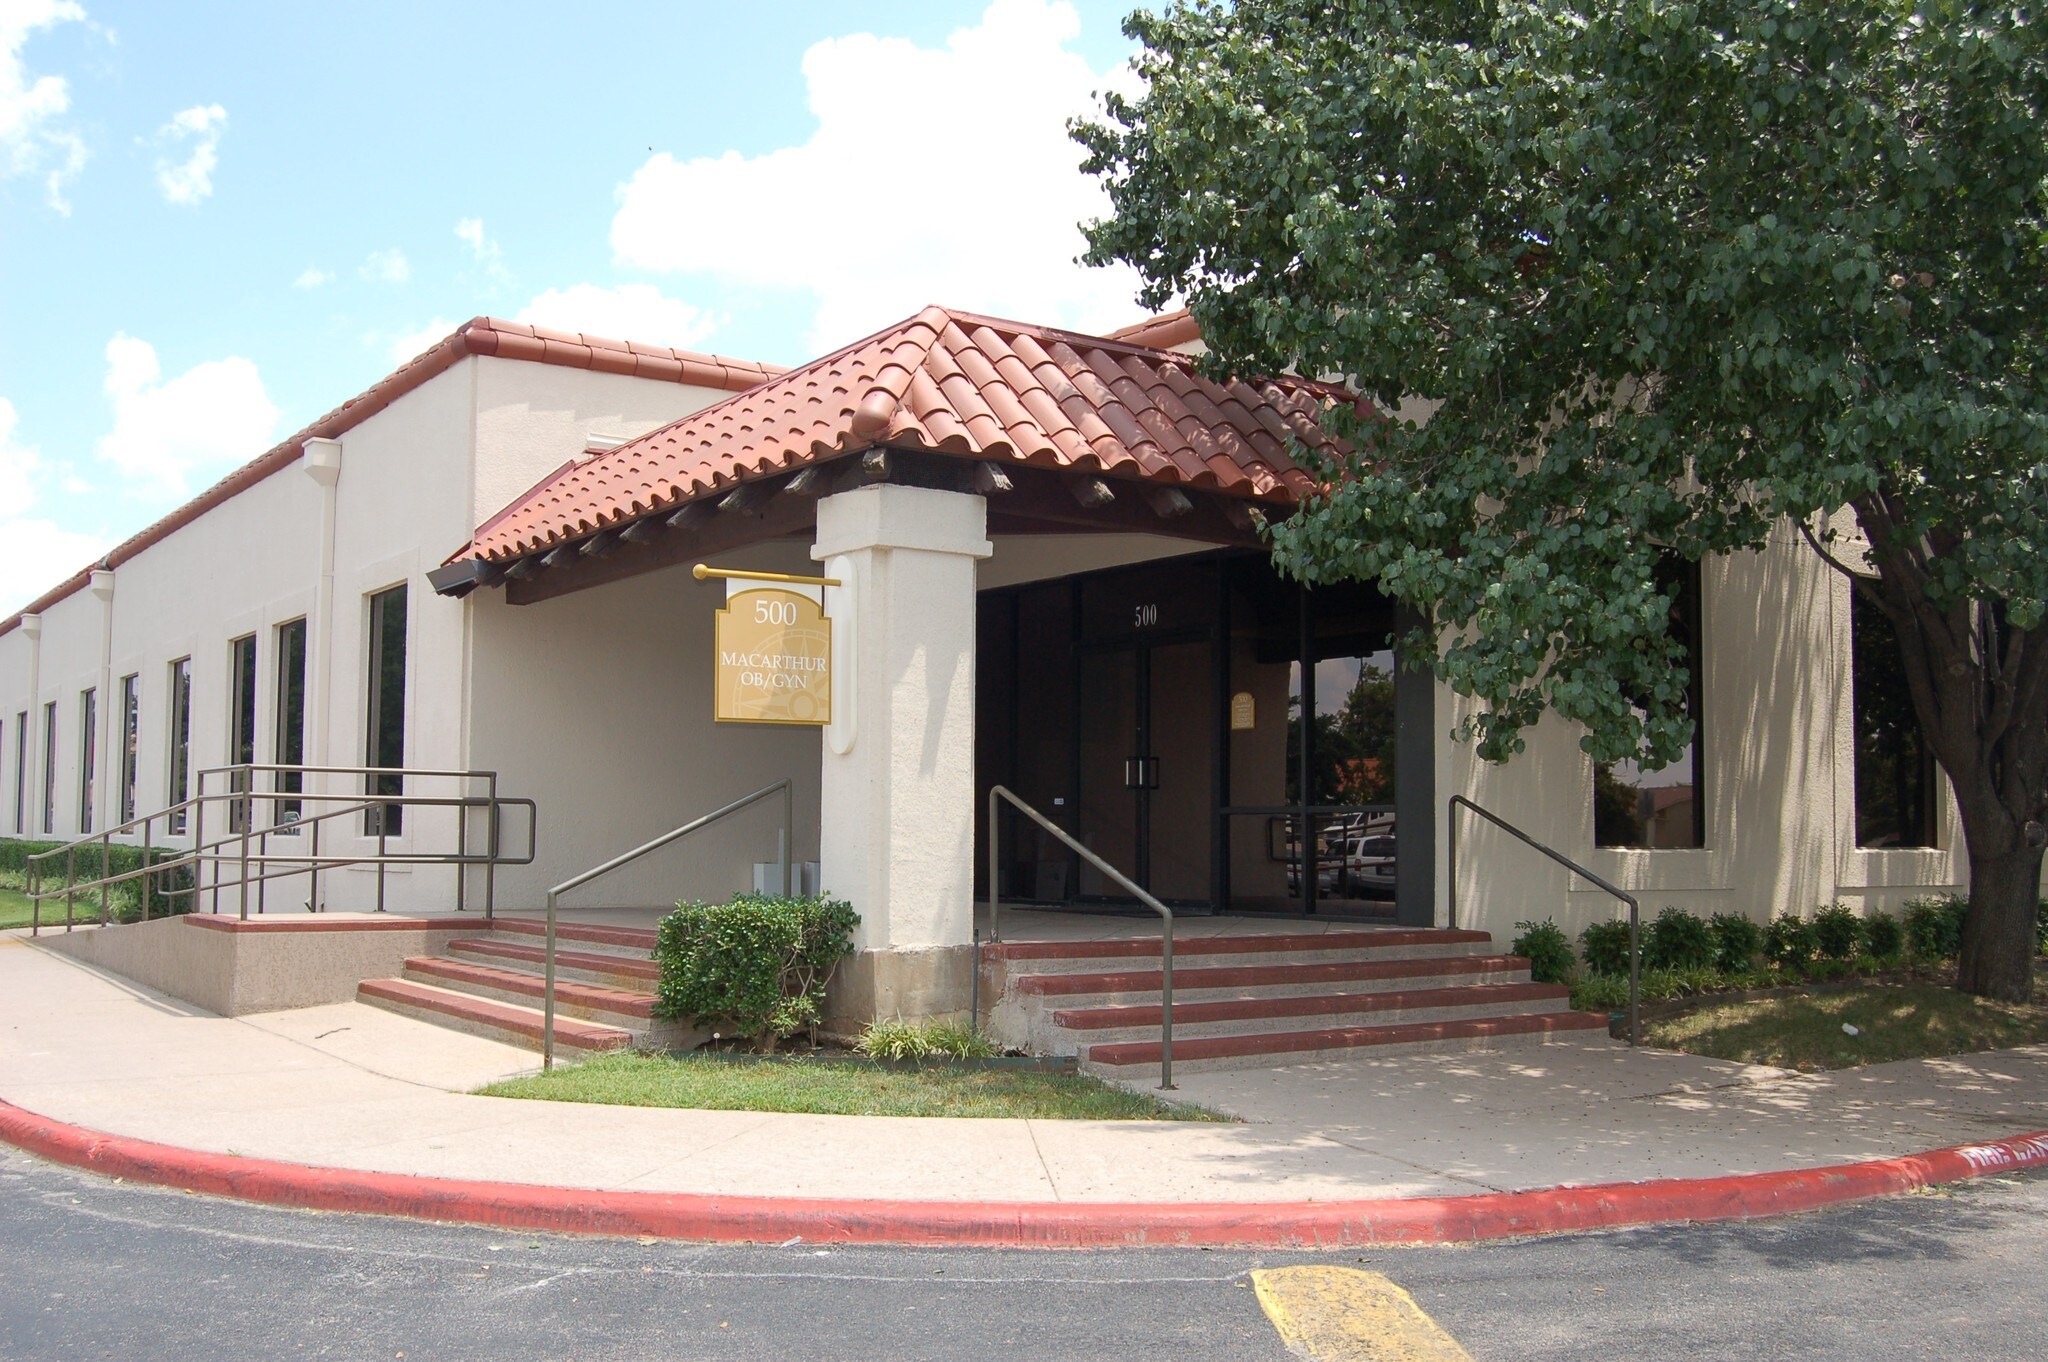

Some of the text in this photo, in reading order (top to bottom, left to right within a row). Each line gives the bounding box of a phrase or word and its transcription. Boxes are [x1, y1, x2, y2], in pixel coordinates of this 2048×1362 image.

[754, 600, 797, 626] 500
[1134, 603, 1157, 628] 500
[721, 651, 827, 672] MACARTHUR
[740, 671, 807, 690] OB/GYN
[1953, 1145, 2011, 1169] FIRE
